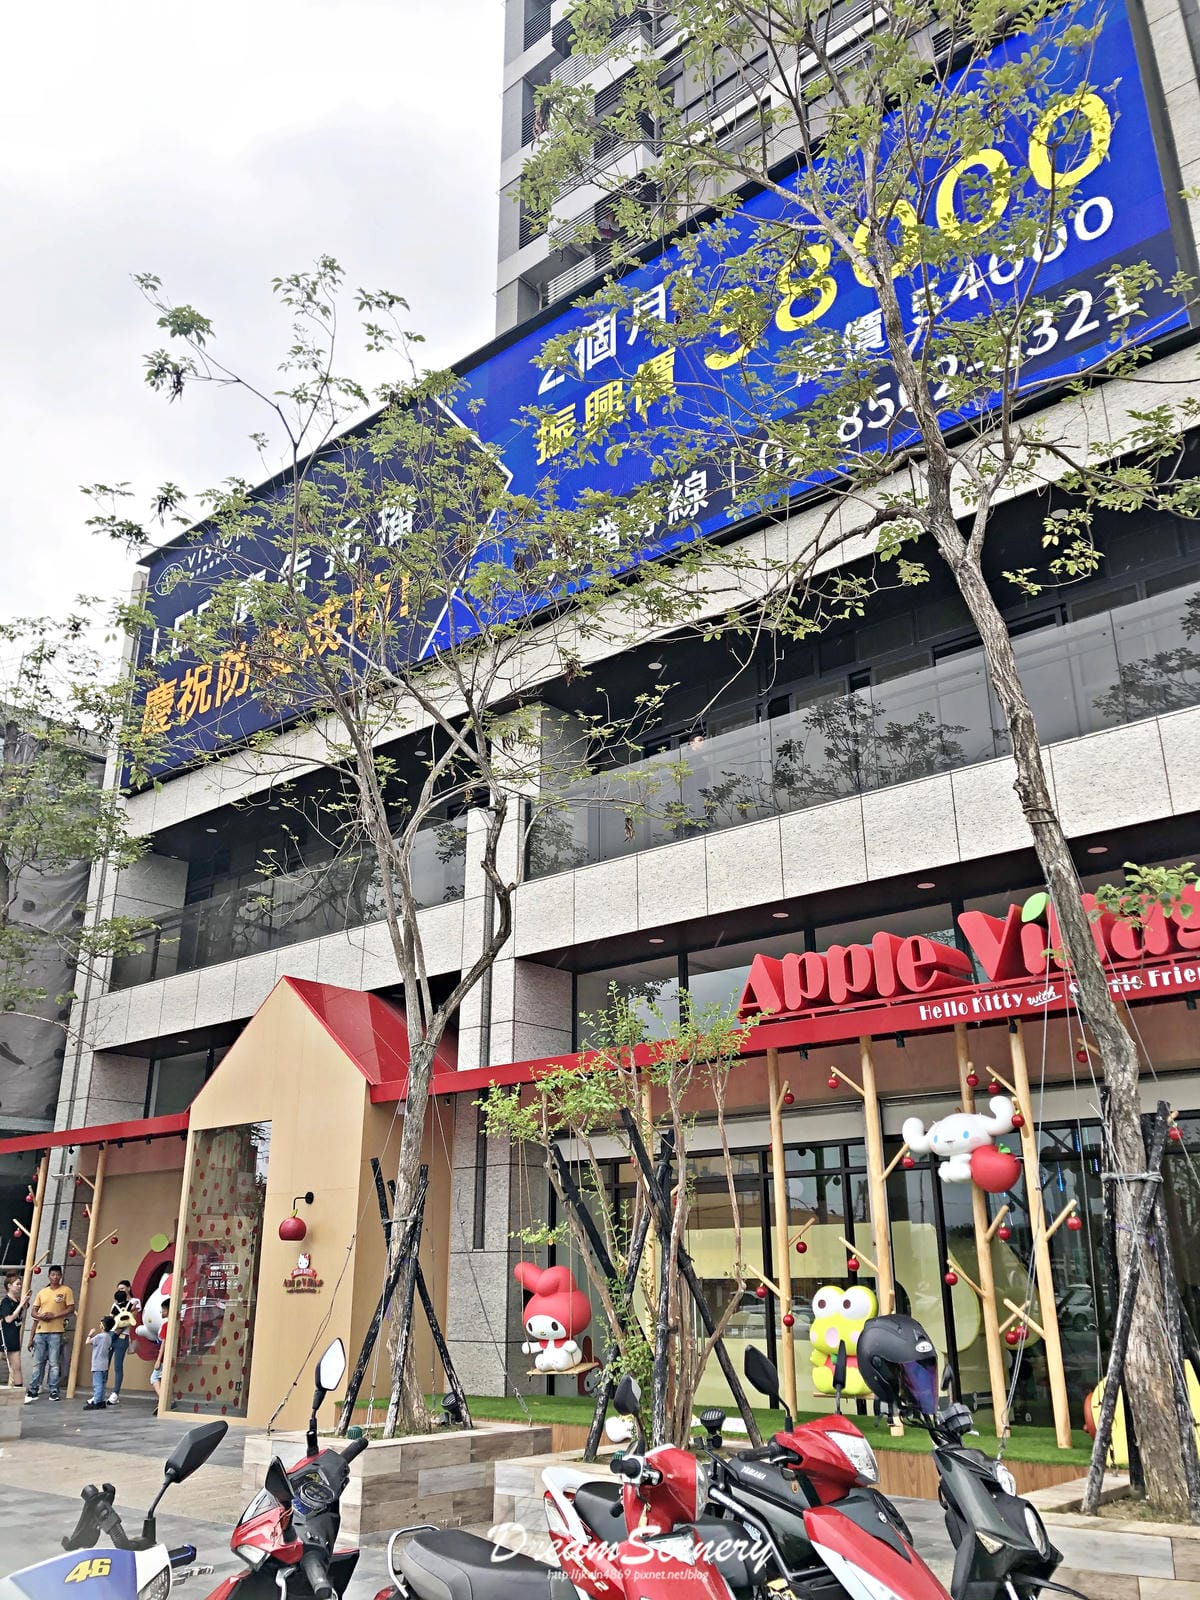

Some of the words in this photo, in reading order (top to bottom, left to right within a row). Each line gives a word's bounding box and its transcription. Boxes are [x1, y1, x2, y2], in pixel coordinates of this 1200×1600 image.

[737, 930, 955, 1018] Apple
[919, 1000, 968, 1020] Hello
[972, 992, 1023, 1013] Kitty
[1026, 985, 1062, 1007] with
[1148, 966, 1200, 988] Frie
[64, 1557, 112, 1584] 46
